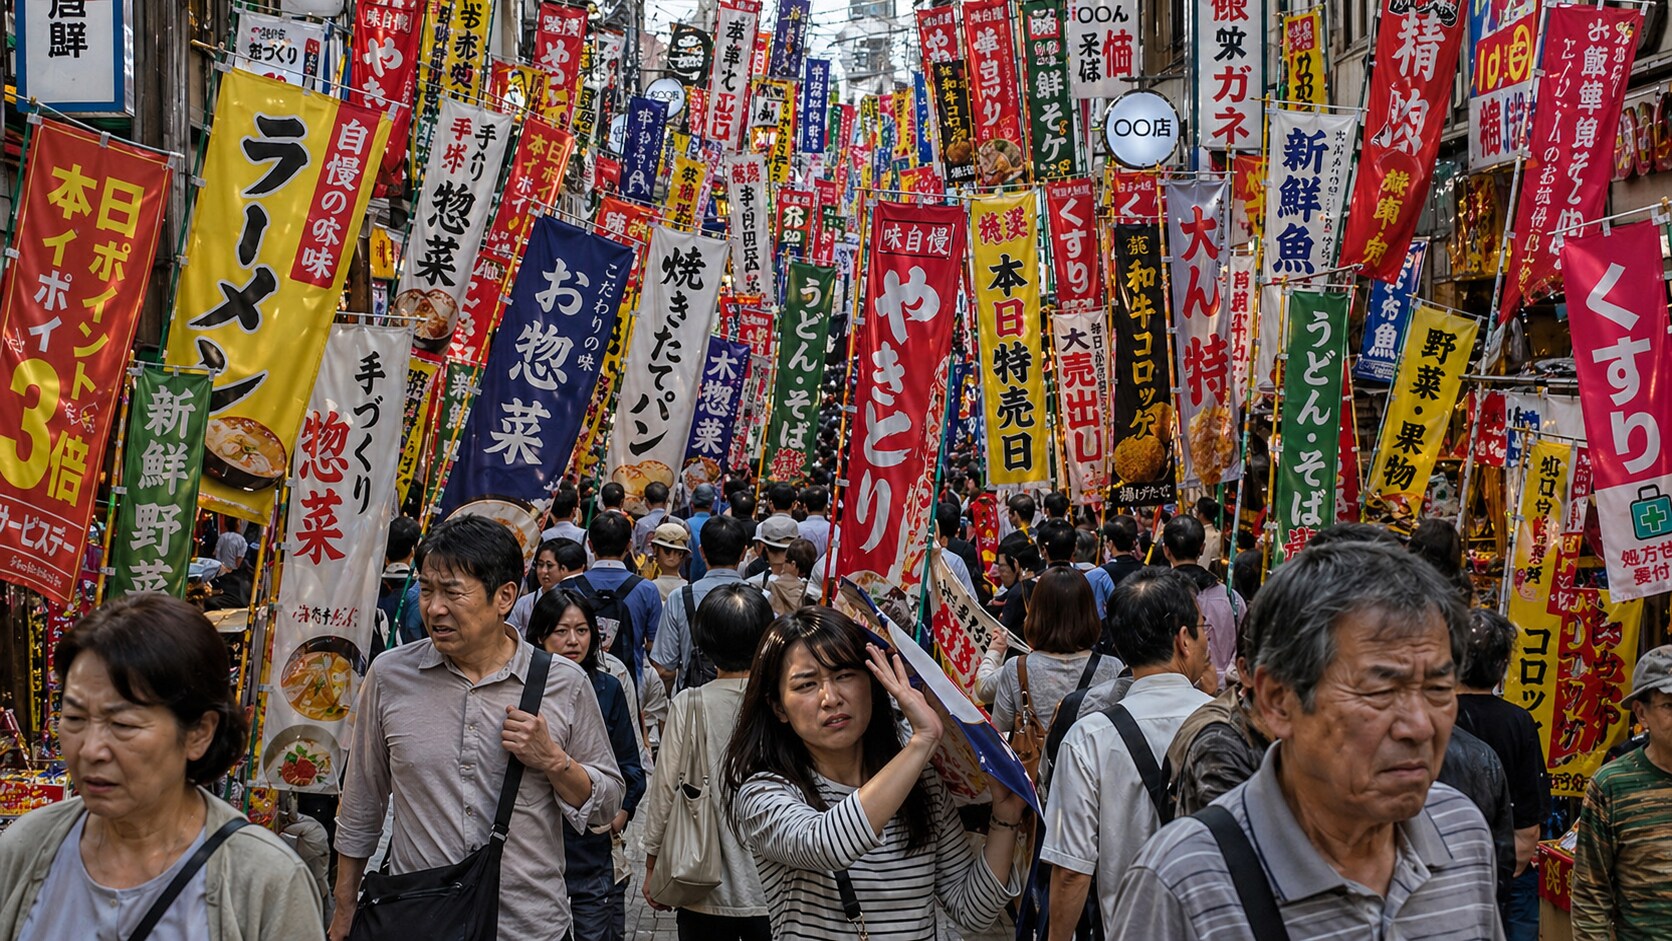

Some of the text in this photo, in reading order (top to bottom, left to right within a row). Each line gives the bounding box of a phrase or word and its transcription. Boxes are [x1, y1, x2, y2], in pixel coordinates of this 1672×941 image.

[186, 112, 311, 415] ラーメン
[413, 181, 477, 287] 惣菜
[1059, 198, 1089, 293] くすり
[1272, 127, 1329, 273] 新鮮魚
[483, 257, 590, 466] お惣菜
[577, 262, 618, 372] こだわりの味
[629, 246, 707, 457] 焼きたてパン
[779, 277, 825, 450] うどん・そば
[987, 253, 1035, 473] 本日特売日
[1126, 259, 1156, 440] 和牛コロッケ
[1585, 262, 1661, 474] くすり
[294, 411, 350, 565] 惣菜
[354, 351, 386, 515] 手づくり
[856, 265, 941, 555] やきとり
[1290, 311, 1336, 526] うどん・そば
[1384, 327, 1458, 491] 野菜・果物
[1520, 628, 1551, 731] コロッ
